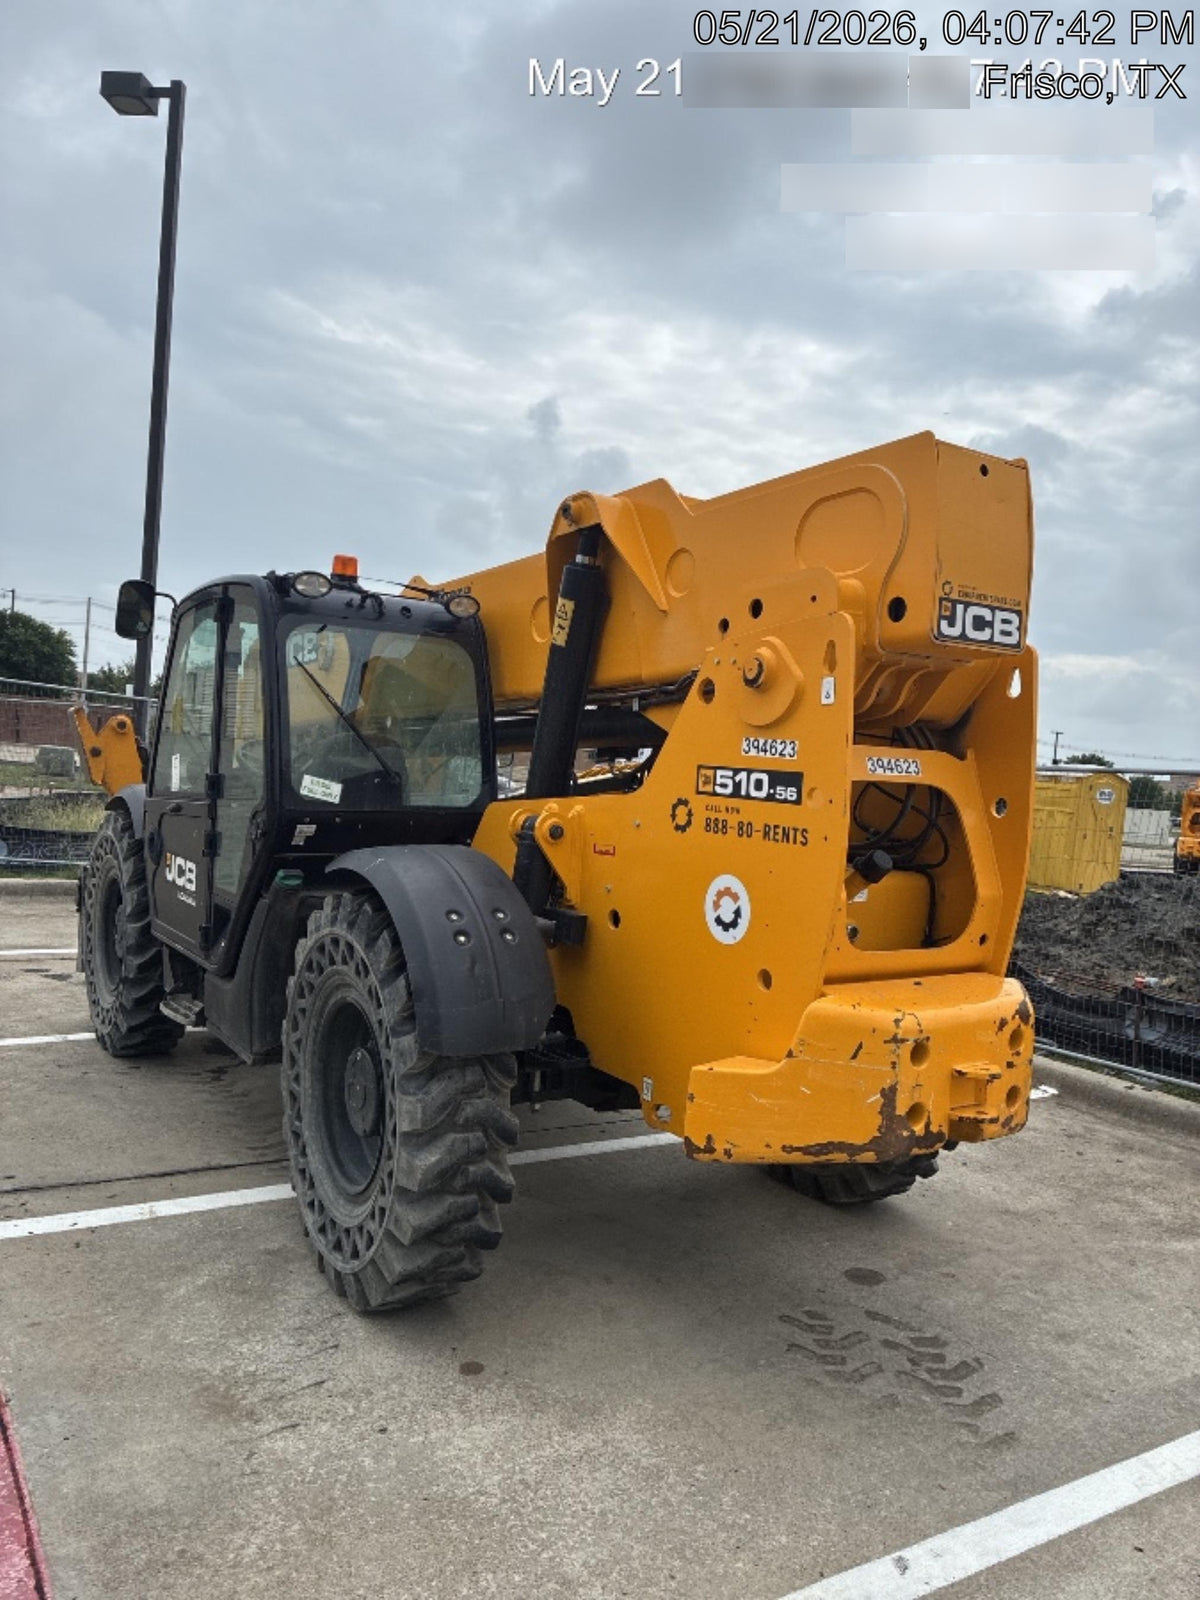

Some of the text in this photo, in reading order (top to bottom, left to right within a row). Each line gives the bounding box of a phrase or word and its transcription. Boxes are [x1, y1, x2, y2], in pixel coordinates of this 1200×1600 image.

[940, 603, 1020, 645] JCB
[742, 737, 797, 758] 394623
[867, 757, 920, 775] 394623
[704, 817, 808, 847] 888-80-RENTS
[166, 854, 196, 891] JCB
